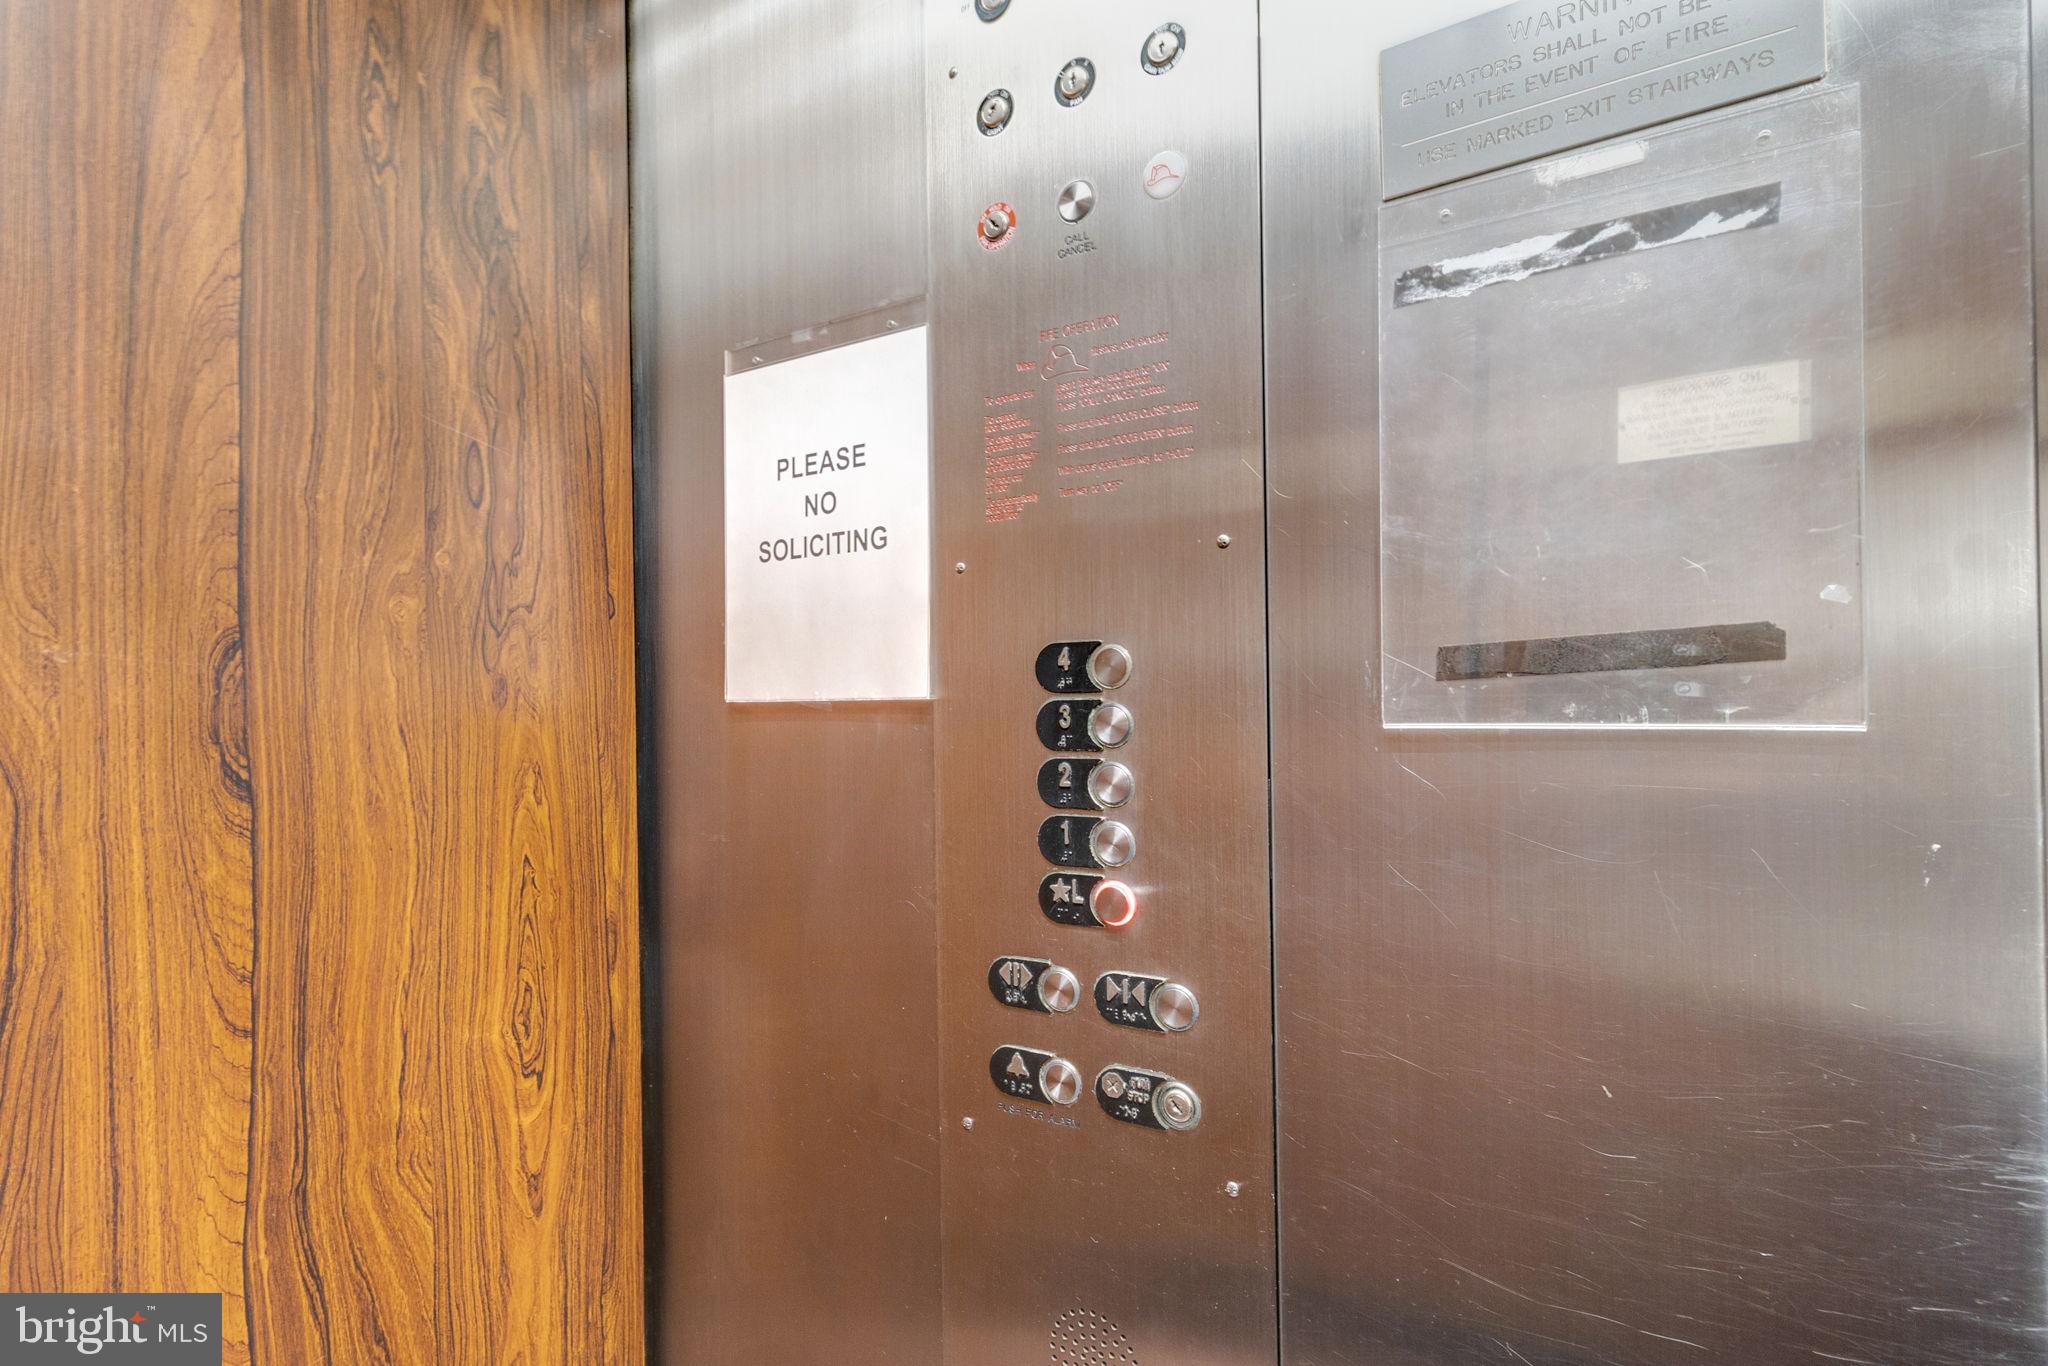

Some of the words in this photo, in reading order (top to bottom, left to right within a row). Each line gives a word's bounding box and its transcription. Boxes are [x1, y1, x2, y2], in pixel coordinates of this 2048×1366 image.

[1506, 0, 1632, 44] WARNI
[1401, 53, 1522, 109] ELEVATORS
[1532, 29, 1607, 63] SHALL
[1618, 5, 1667, 36] NOT
[1679, 0, 1712, 17] BE
[1445, 97, 1464, 118] IN
[1477, 80, 1518, 109] THE
[1525, 55, 1600, 94] EVENT
[1614, 41, 1646, 65] OF
[1667, 15, 1729, 49] FIRE
[1417, 141, 1458, 168] USE
[1466, 114, 1554, 154] MARKED
[1565, 94, 1616, 123] EXIT
[1628, 49, 1776, 105] STAIRWAYS
[1057, 241, 1097, 259] CANCEL
[1064, 231, 1090, 246] CALL
[777, 443, 867, 481] PLEASE
[804, 491, 837, 518] NO
[759, 526, 888, 563] SOLICITING
[1057, 646, 1071, 671] 4
[1059, 704, 1072, 730] 3
[1058, 762, 1072, 788] 2
[1060, 820, 1070, 846] 1
[1072, 879, 1085, 905] L
[1127, 1090, 1150, 1105] STOP
[1025, 1107, 1045, 1121] FOR
